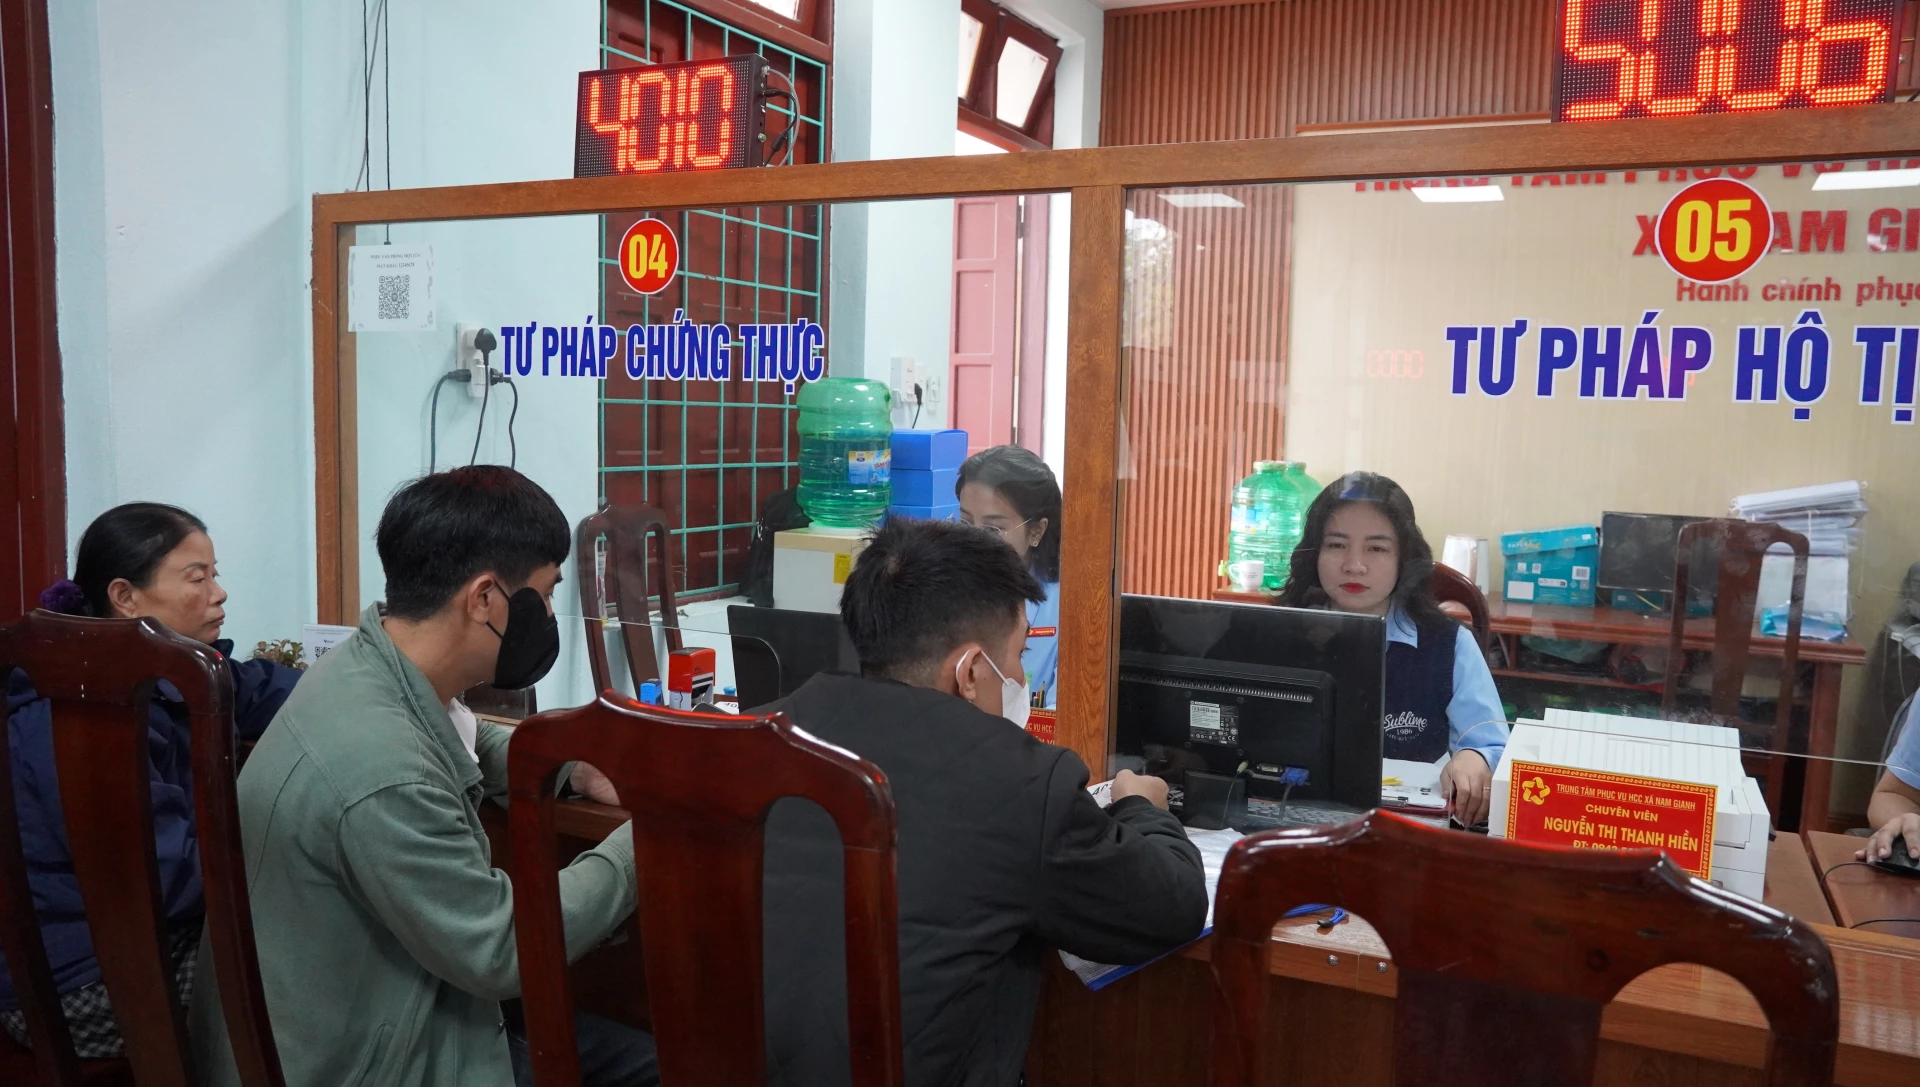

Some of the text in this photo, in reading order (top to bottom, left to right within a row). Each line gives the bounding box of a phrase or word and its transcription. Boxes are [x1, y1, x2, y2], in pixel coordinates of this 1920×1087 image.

[1564, 0, 1888, 119] 5006
[589, 65, 733, 172] 4010
[1675, 199, 1752, 263] 05
[1766, 209, 1848, 253] AM
[628, 234, 668, 279] 04
[1761, 276, 1842, 302] chính
[501, 308, 825, 394] TƯ PHÁP CHỨNG THỰC
[1445, 308, 1920, 425] TƯ PHÁP HỘ TỊ
[1384, 711, 1428, 732] Sublime
[1556, 783, 1580, 795] TRUNG
[1580, 785, 1596, 797] TÂM
[1628, 793, 1643, 803] HCC
[1655, 796, 1672, 807] NAM
[1673, 799, 1696, 810] GIANH
[1585, 803, 1658, 822] CHUYÊN VIÊN
[1543, 815, 1699, 852] NGUYỄN THỊ THANH HIỀN
